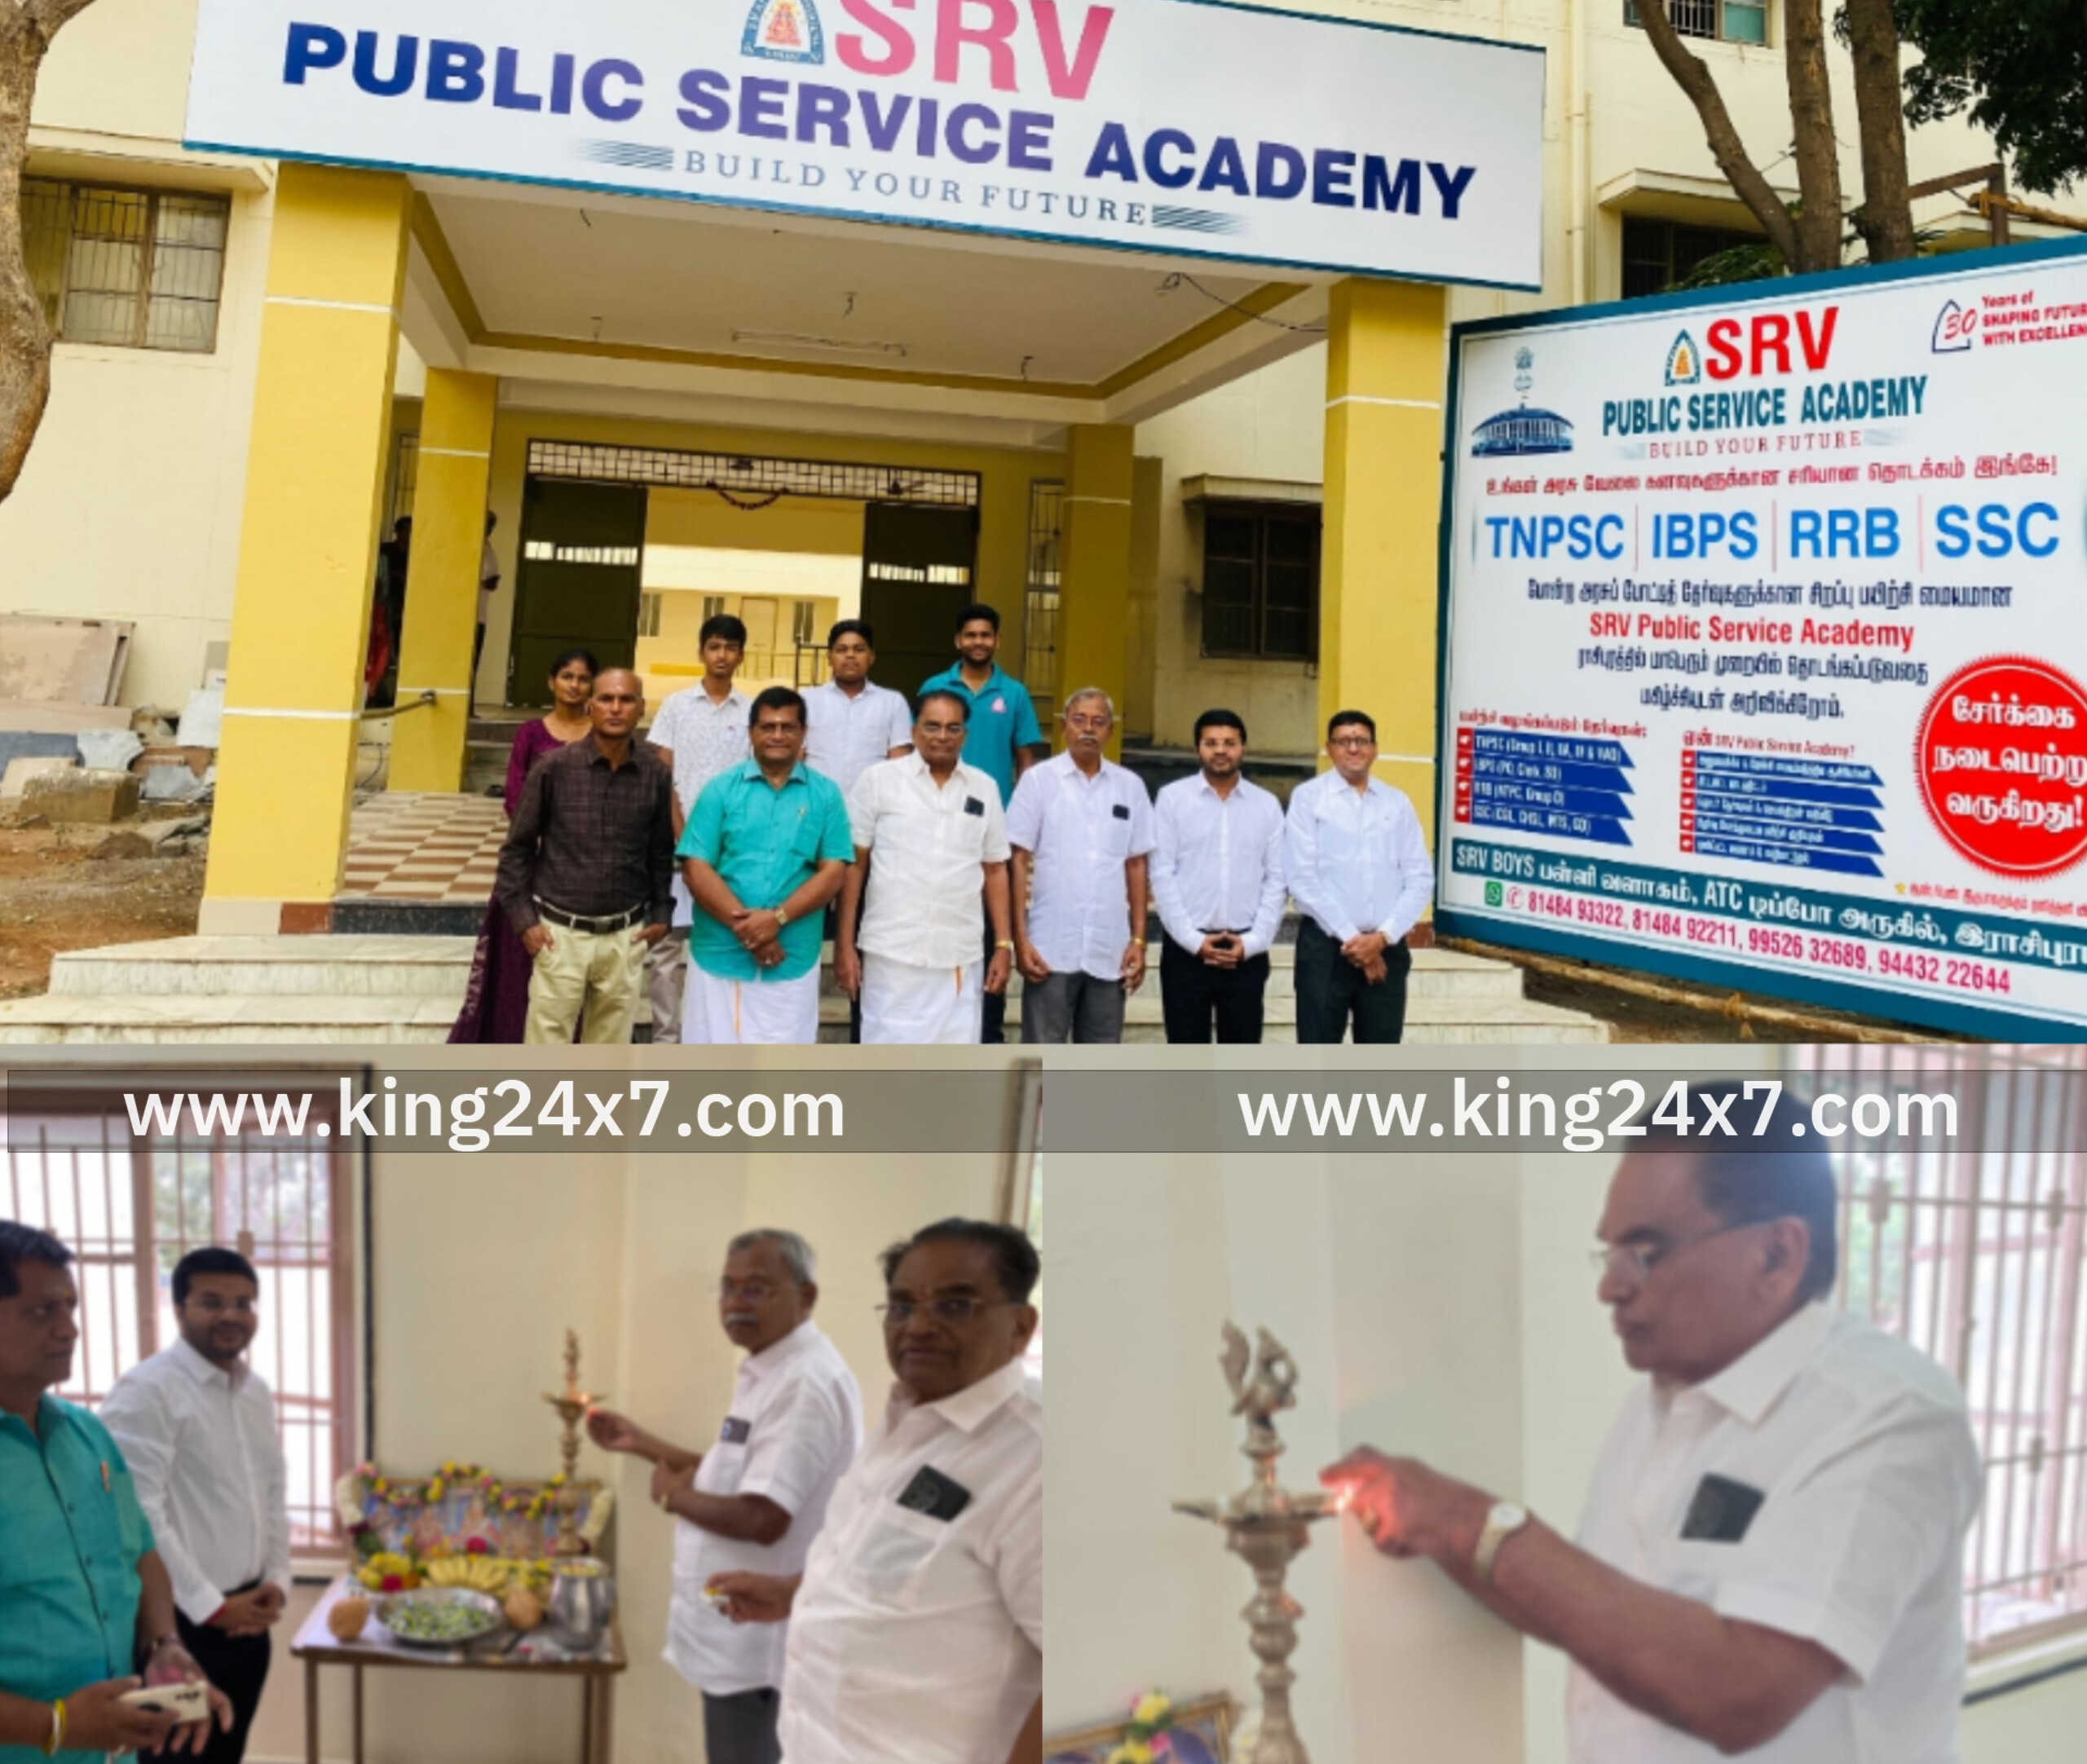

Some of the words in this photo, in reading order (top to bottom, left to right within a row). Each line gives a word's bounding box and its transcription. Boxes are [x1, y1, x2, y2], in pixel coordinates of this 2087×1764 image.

[836, 0, 1114, 101] SRV
[283, 21, 644, 122] PUBLIC
[676, 68, 1054, 172] SERVICE
[1084, 122, 1476, 220] ACADEMY
[686, 150, 827, 187] BUILD
[846, 169, 962, 204] YOUR
[981, 186, 1147, 227] FUTURE
[1982, 293, 2018, 308] Years
[2022, 289, 2035, 304] of
[1982, 309, 2040, 328] SHAPING
[1705, 306, 1839, 381] SRV
[1944, 308, 1978, 340] 30
[1982, 330, 2015, 346] WITH
[1603, 396, 1681, 436] PUBLIC
[1688, 387, 1785, 432] SERVICE
[1800, 374, 1929, 423] ACADEMY
[1649, 441, 1709, 459] BUILD
[1715, 436, 1768, 456] YOUR
[1776, 430, 1863, 452] FUTURE
[1868, 455, 1966, 483] தொடக்கம்
[1974, 452, 2058, 479] இங்கே!
[1485, 514, 1625, 560] TNPSC
[1652, 510, 1758, 560] IBPS
[1790, 507, 1901, 558] RRB
[1935, 502, 2060, 558] SSC
[1590, 611, 1631, 637] SRV
[1638, 613, 1701, 640] Public
[1709, 615, 1793, 645] Service
[1800, 618, 1914, 653] Academy
[1952, 691, 2076, 729] சேர்க்கை
[1945, 787, 2084, 833] வருகிறது!
[1456, 844, 1489, 870] SRV
[1492, 849, 1535, 878] BOYS
[1539, 858, 1597, 888] பள்ளி
[1600, 874, 1698, 906] வளாகம்,
[1705, 880, 1743, 911] ATC
[1749, 890, 1833, 926] டிப்போ
[1838, 907, 1948, 946] அருகில்,
[1528, 890, 1573, 918] 81484
[1632, 908, 1681, 937] 81484
[1687, 917, 1743, 952] 92211,
[1749, 927, 1803, 959] 99526
[1808, 937, 1873, 973] 32689,
[1878, 948, 1939, 983] 94432
[1946, 958, 2011, 994] 22644
